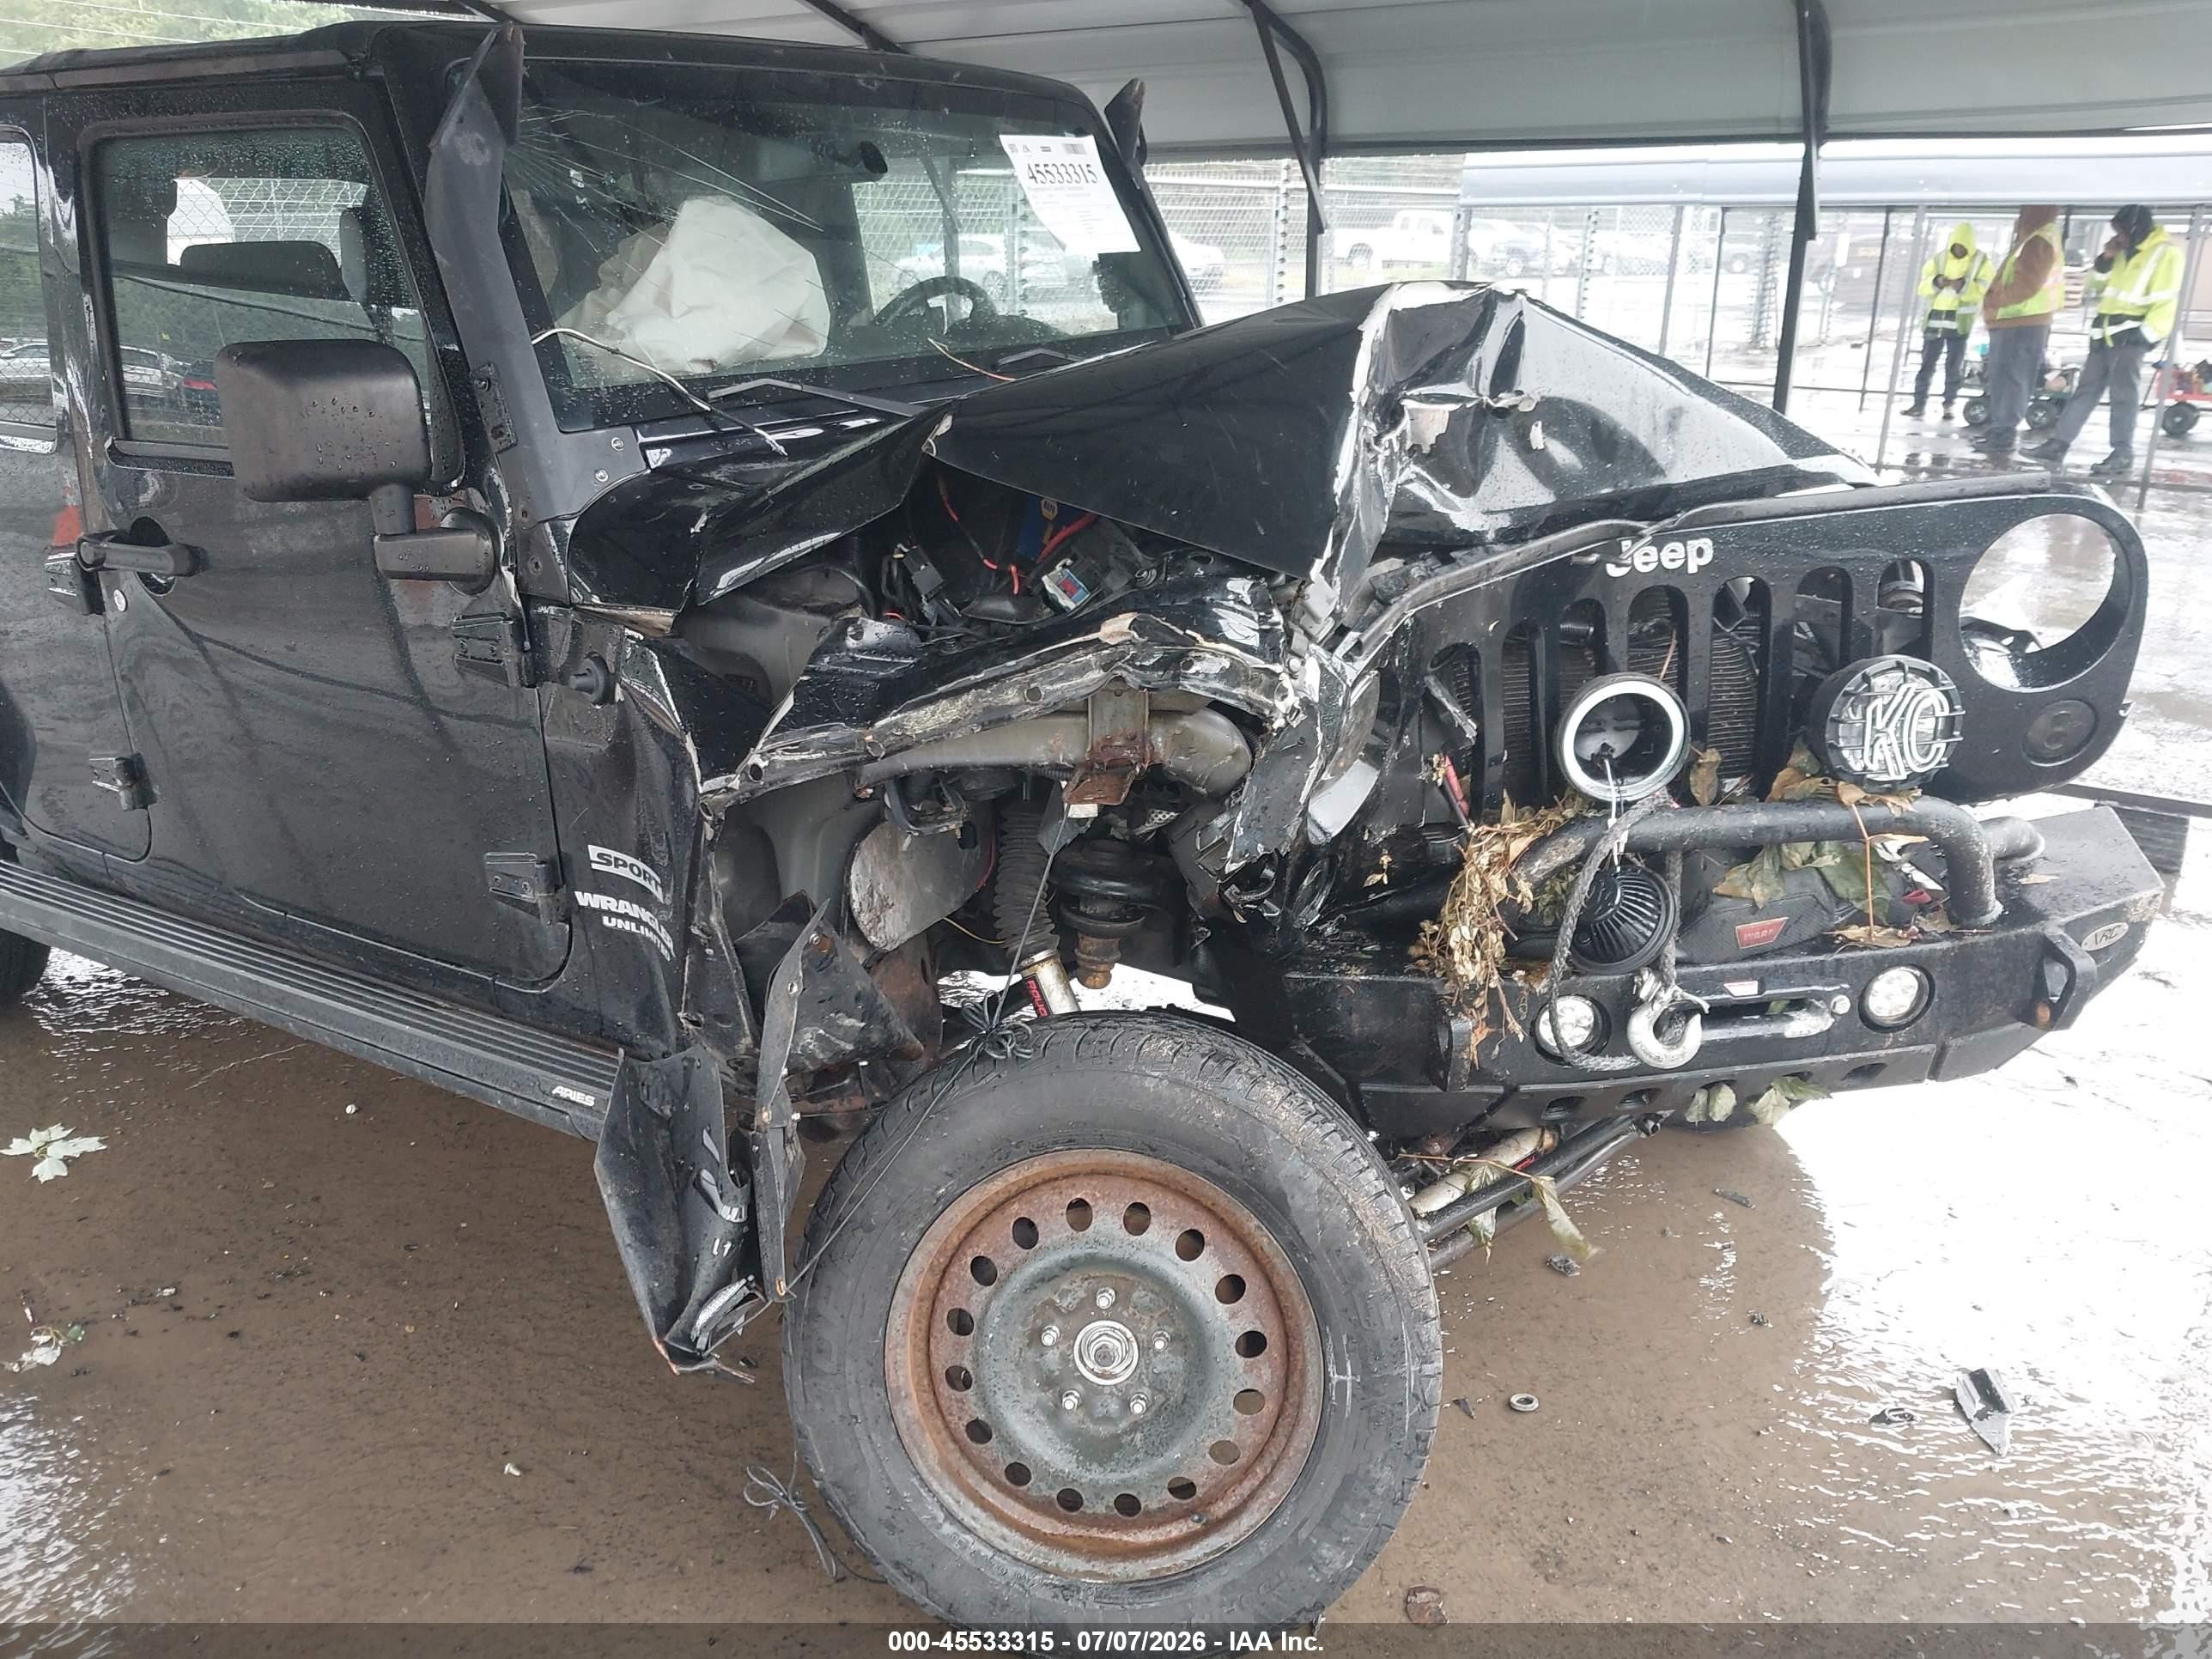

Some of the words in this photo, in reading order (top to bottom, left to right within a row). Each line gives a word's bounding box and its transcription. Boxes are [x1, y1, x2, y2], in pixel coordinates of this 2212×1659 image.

[1027, 163, 1098, 184] 45533315
[1606, 538, 1714, 578] Jeep
[1863, 683, 1950, 781] KC
[589, 851, 663, 896] SPORT
[574, 890, 677, 957] WRANGLER
[602, 915, 672, 962] UNLIMITED
[1025, 979, 1048, 1018] ROUG
[551, 1085, 596, 1106] ARIES
